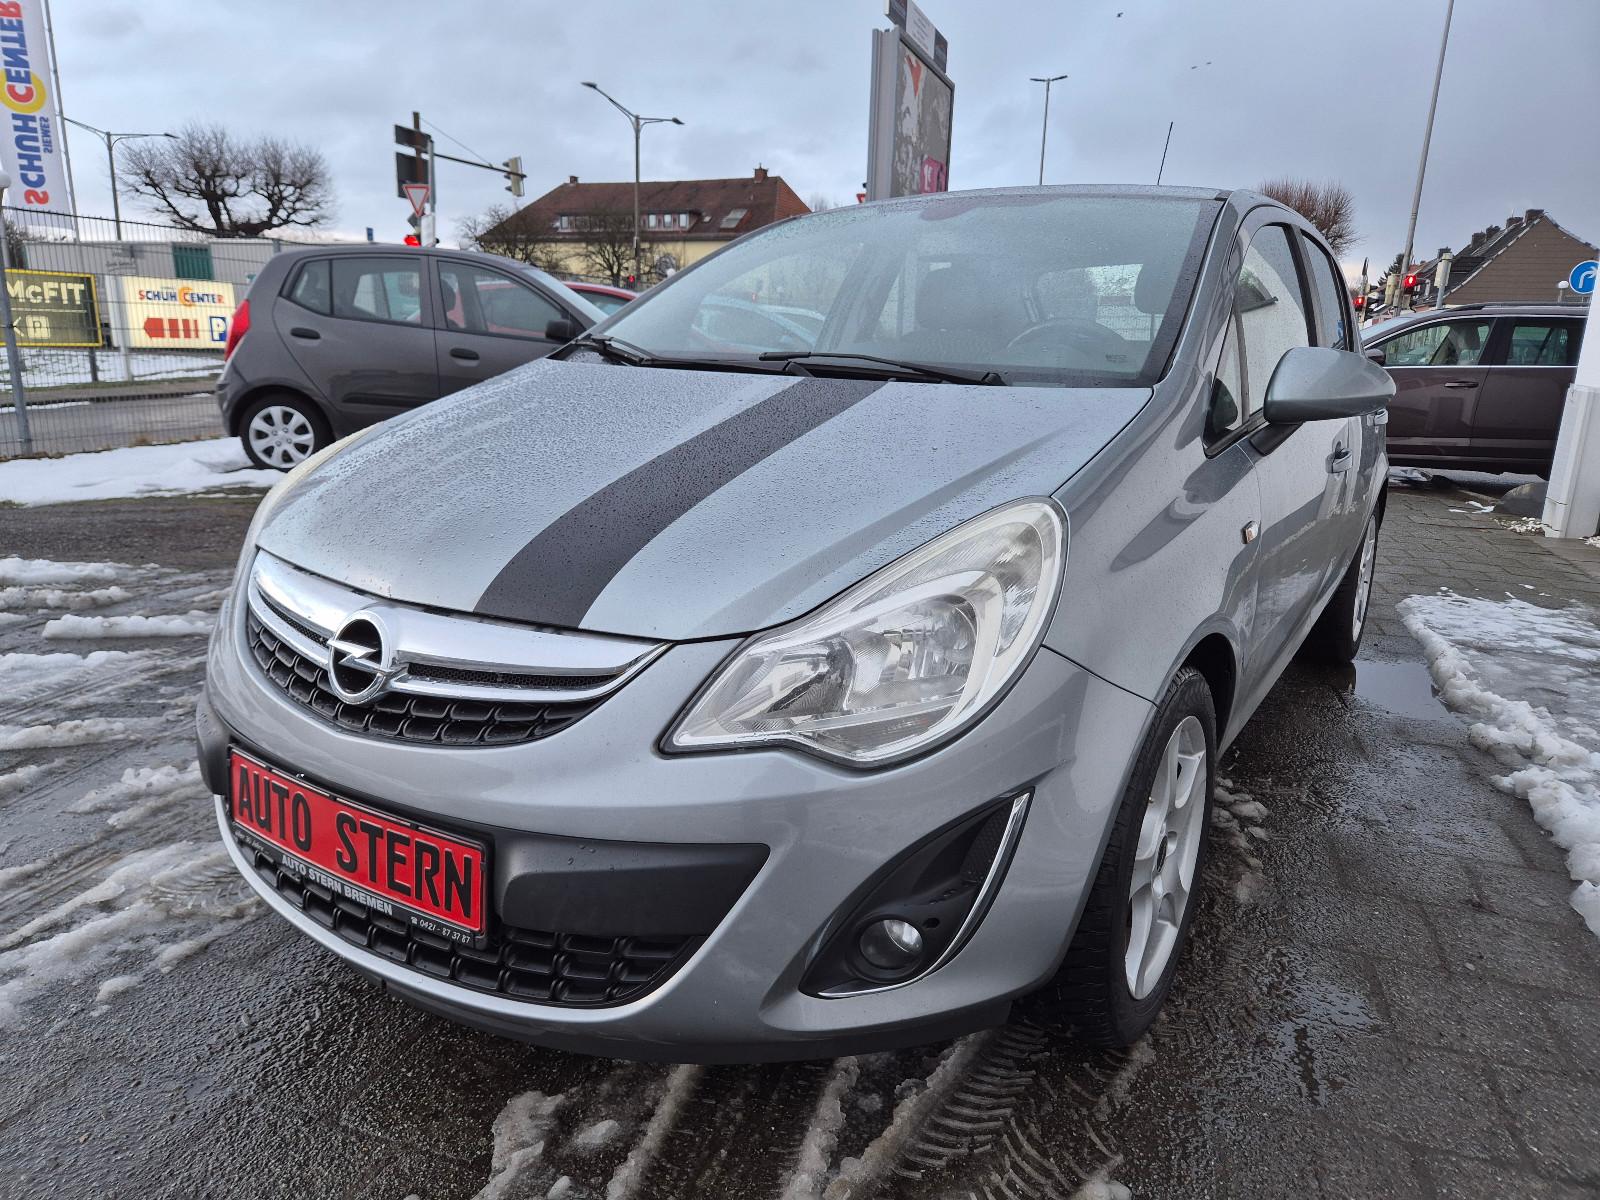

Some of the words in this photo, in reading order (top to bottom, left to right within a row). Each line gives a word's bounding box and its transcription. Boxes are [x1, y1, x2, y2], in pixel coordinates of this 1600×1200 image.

[139, 290, 177, 301] SCHUH
[183, 292, 224, 304] CENTER
[211, 317, 226, 340] P
[238, 764, 312, 852] AUTO
[335, 811, 472, 919] STERN
[281, 855, 306, 875] AUTO
[308, 869, 342, 894] STERN
[344, 884, 393, 916] BREMEN
[419, 919, 436, 931] 0421
[452, 931, 461, 940] 37
[461, 934, 471, 944] 87
